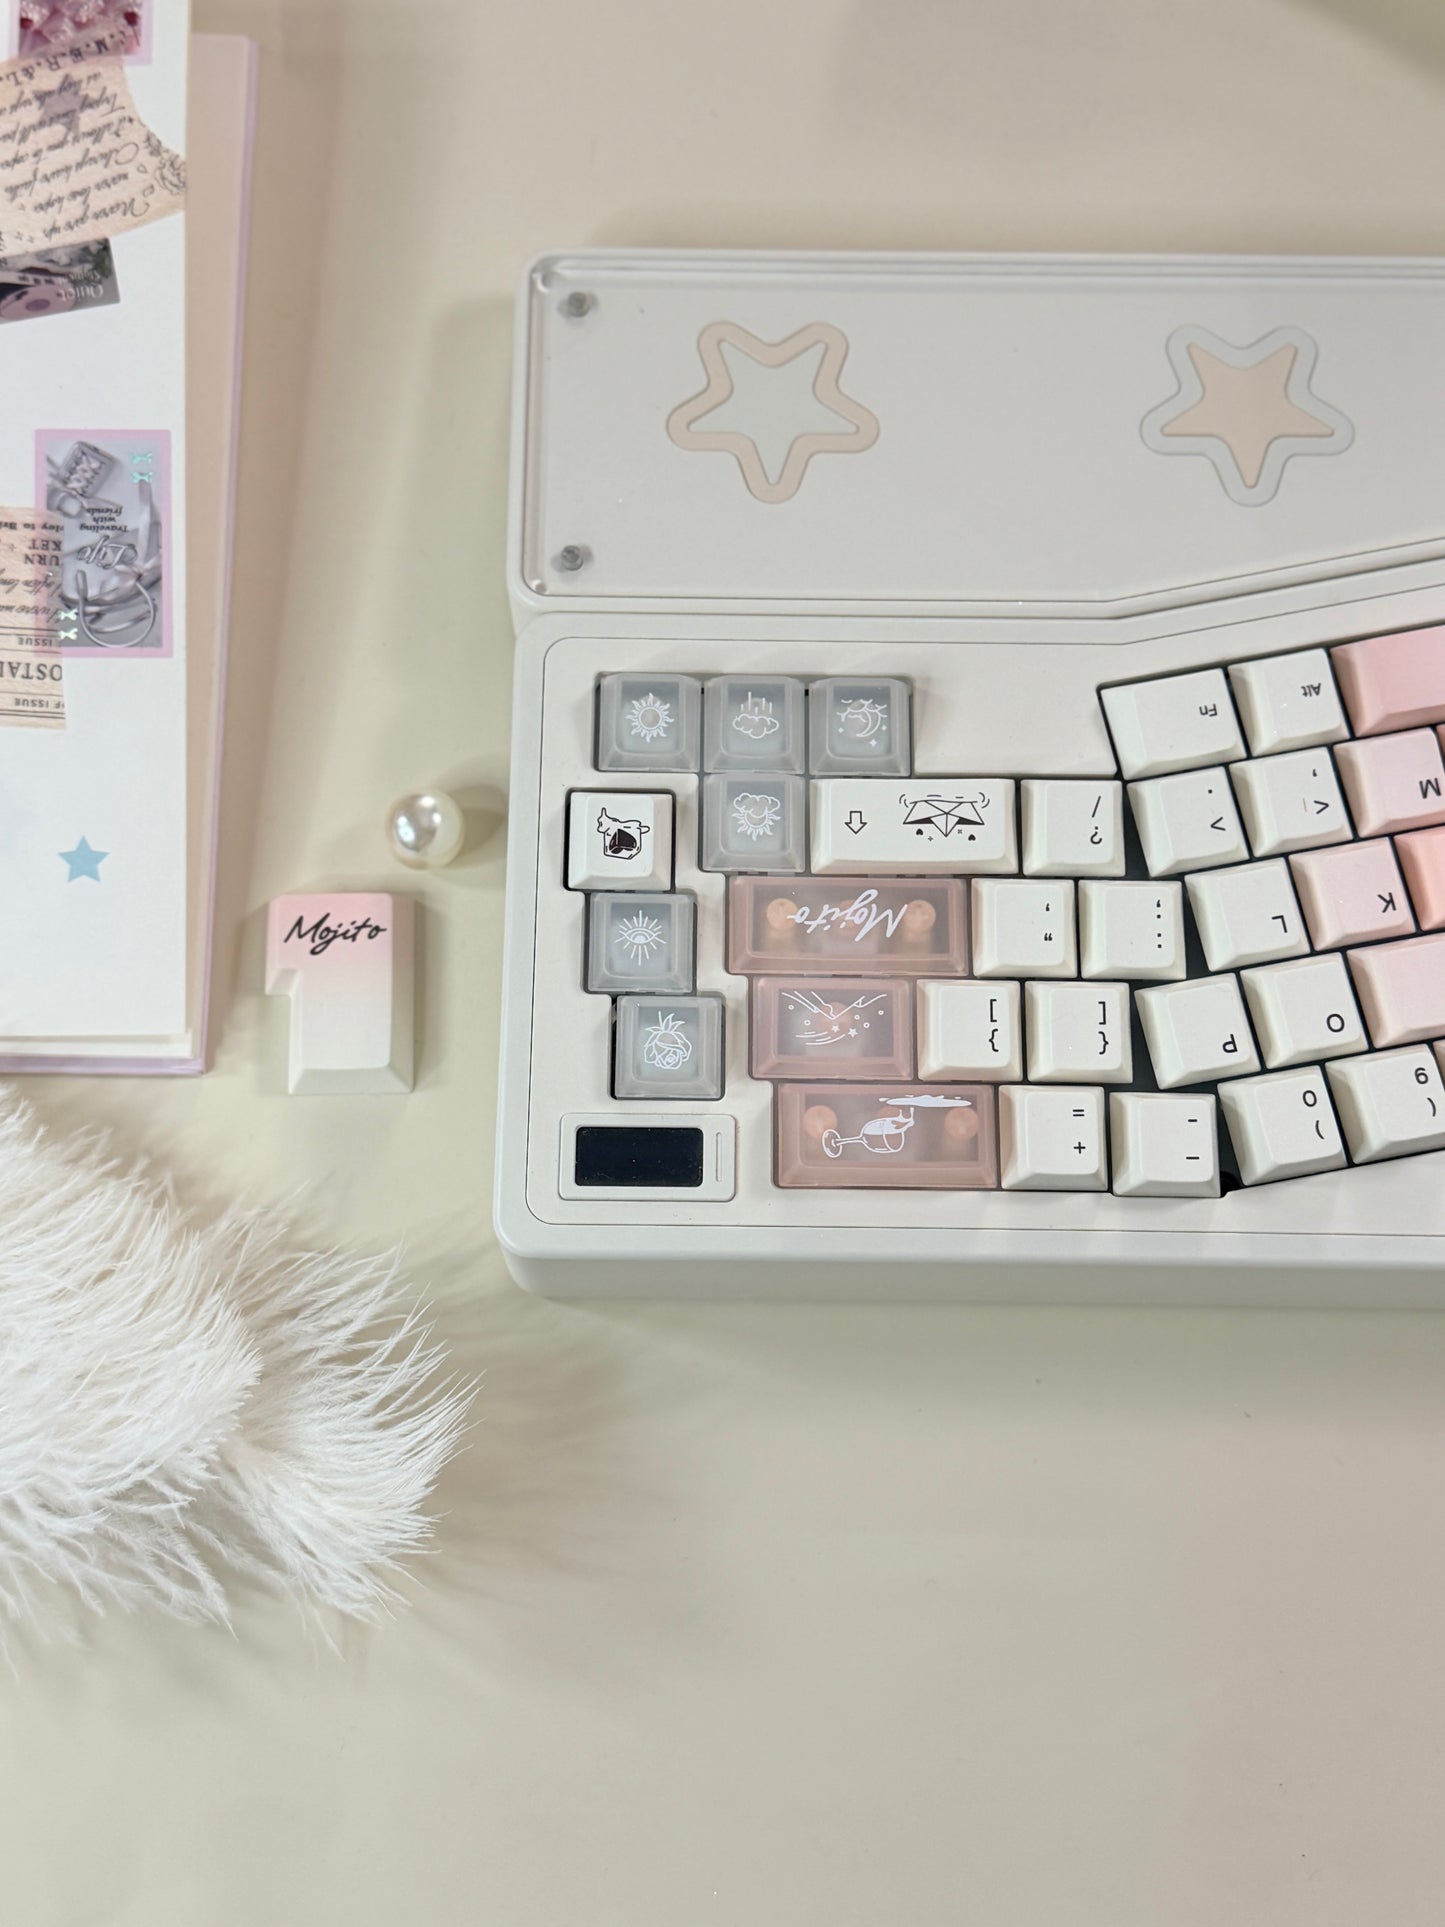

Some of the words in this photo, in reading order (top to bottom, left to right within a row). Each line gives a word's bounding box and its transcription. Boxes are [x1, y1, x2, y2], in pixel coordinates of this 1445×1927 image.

[79, 523, 129, 534] Traveling
[93, 516, 116, 525] with
[76, 534, 138, 571] Life
[16, 637, 53, 647] ISSUE
[1300, 682, 1322, 697] Alt
[13, 697, 49, 709] ISSUE
[1198, 703, 1218, 718] Fn
[1419, 777, 1442, 800] M
[1091, 795, 1102, 818] /
[1313, 800, 1330, 815] <
[1210, 816, 1226, 832] >
[1090, 826, 1103, 845] ?
[1377, 892, 1397, 914] K
[786, 888, 908, 942] Mojito
[1271, 914, 1288, 934] L
[283, 912, 387, 956] Mojito
[1326, 1013, 1345, 1033] O
[1222, 1033, 1238, 1054] P
[1414, 1067, 1429, 1085] 9
[1072, 1108, 1085, 1117] =
[1426, 1097, 1437, 1117] (
[1314, 1119, 1325, 1140] )
[1073, 1141, 1086, 1154] +
